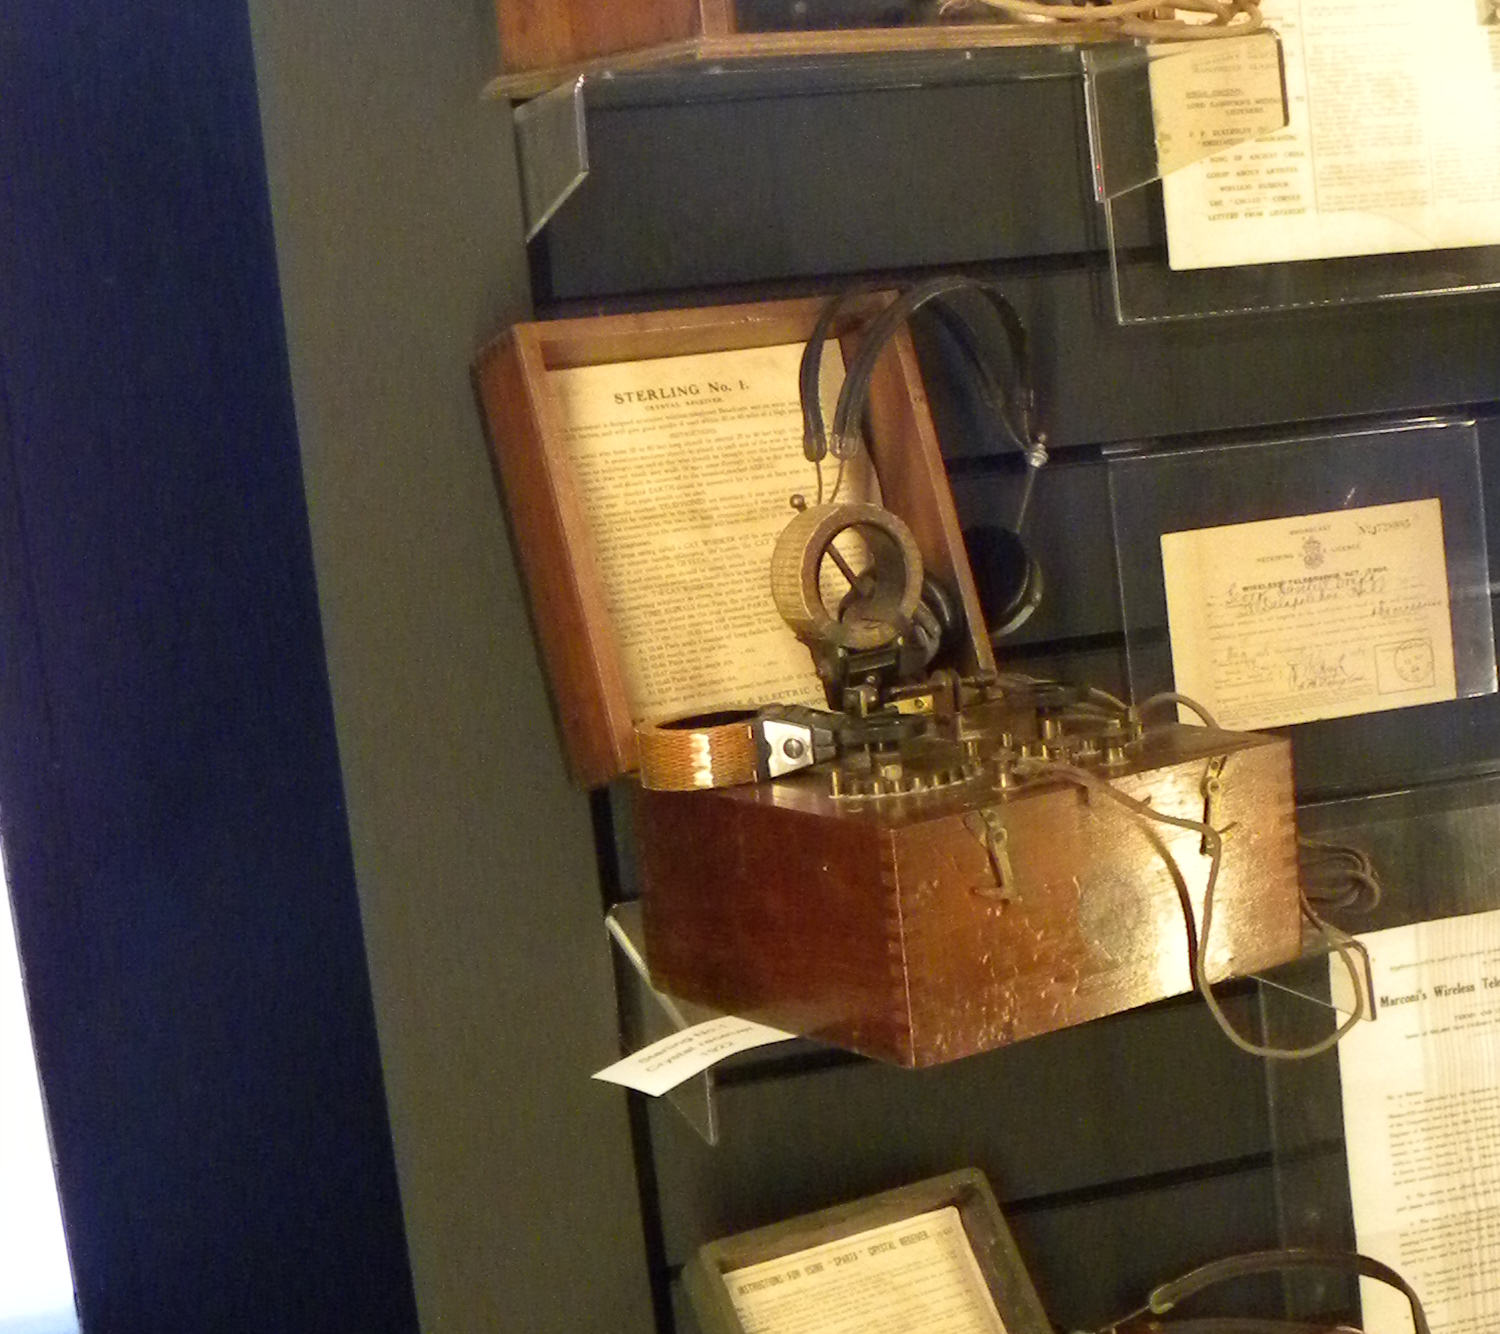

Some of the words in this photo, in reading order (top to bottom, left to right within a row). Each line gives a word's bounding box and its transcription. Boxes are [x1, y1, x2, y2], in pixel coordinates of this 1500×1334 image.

[614, 384, 700, 405] STERLING
[1380, 989, 1427, 1008] Marconi's
[1433, 982, 1475, 998] Wireless
